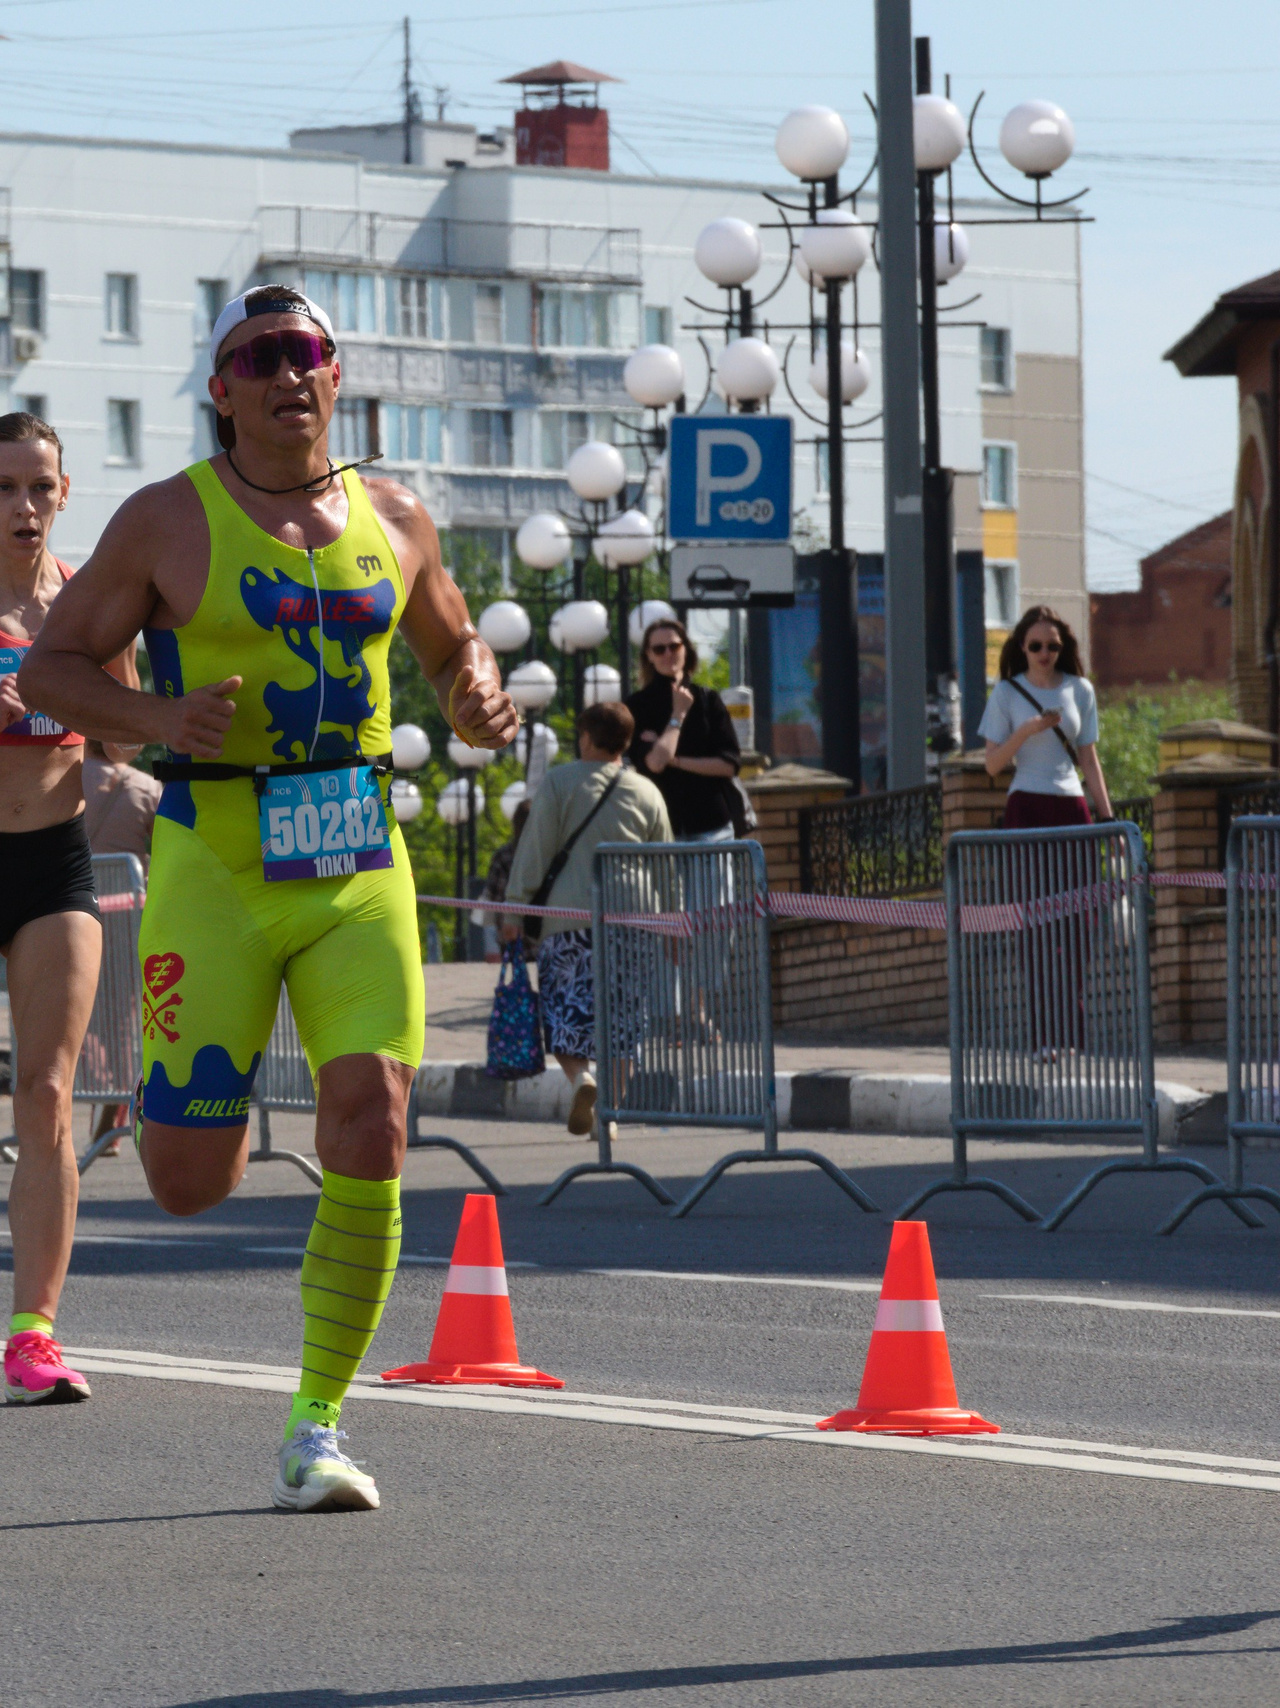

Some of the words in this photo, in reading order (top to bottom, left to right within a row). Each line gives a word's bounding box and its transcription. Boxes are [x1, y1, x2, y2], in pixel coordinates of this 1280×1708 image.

[696, 429, 762, 526] P
[753, 502, 770, 519] 20
[268, 796, 384, 856] 50282
